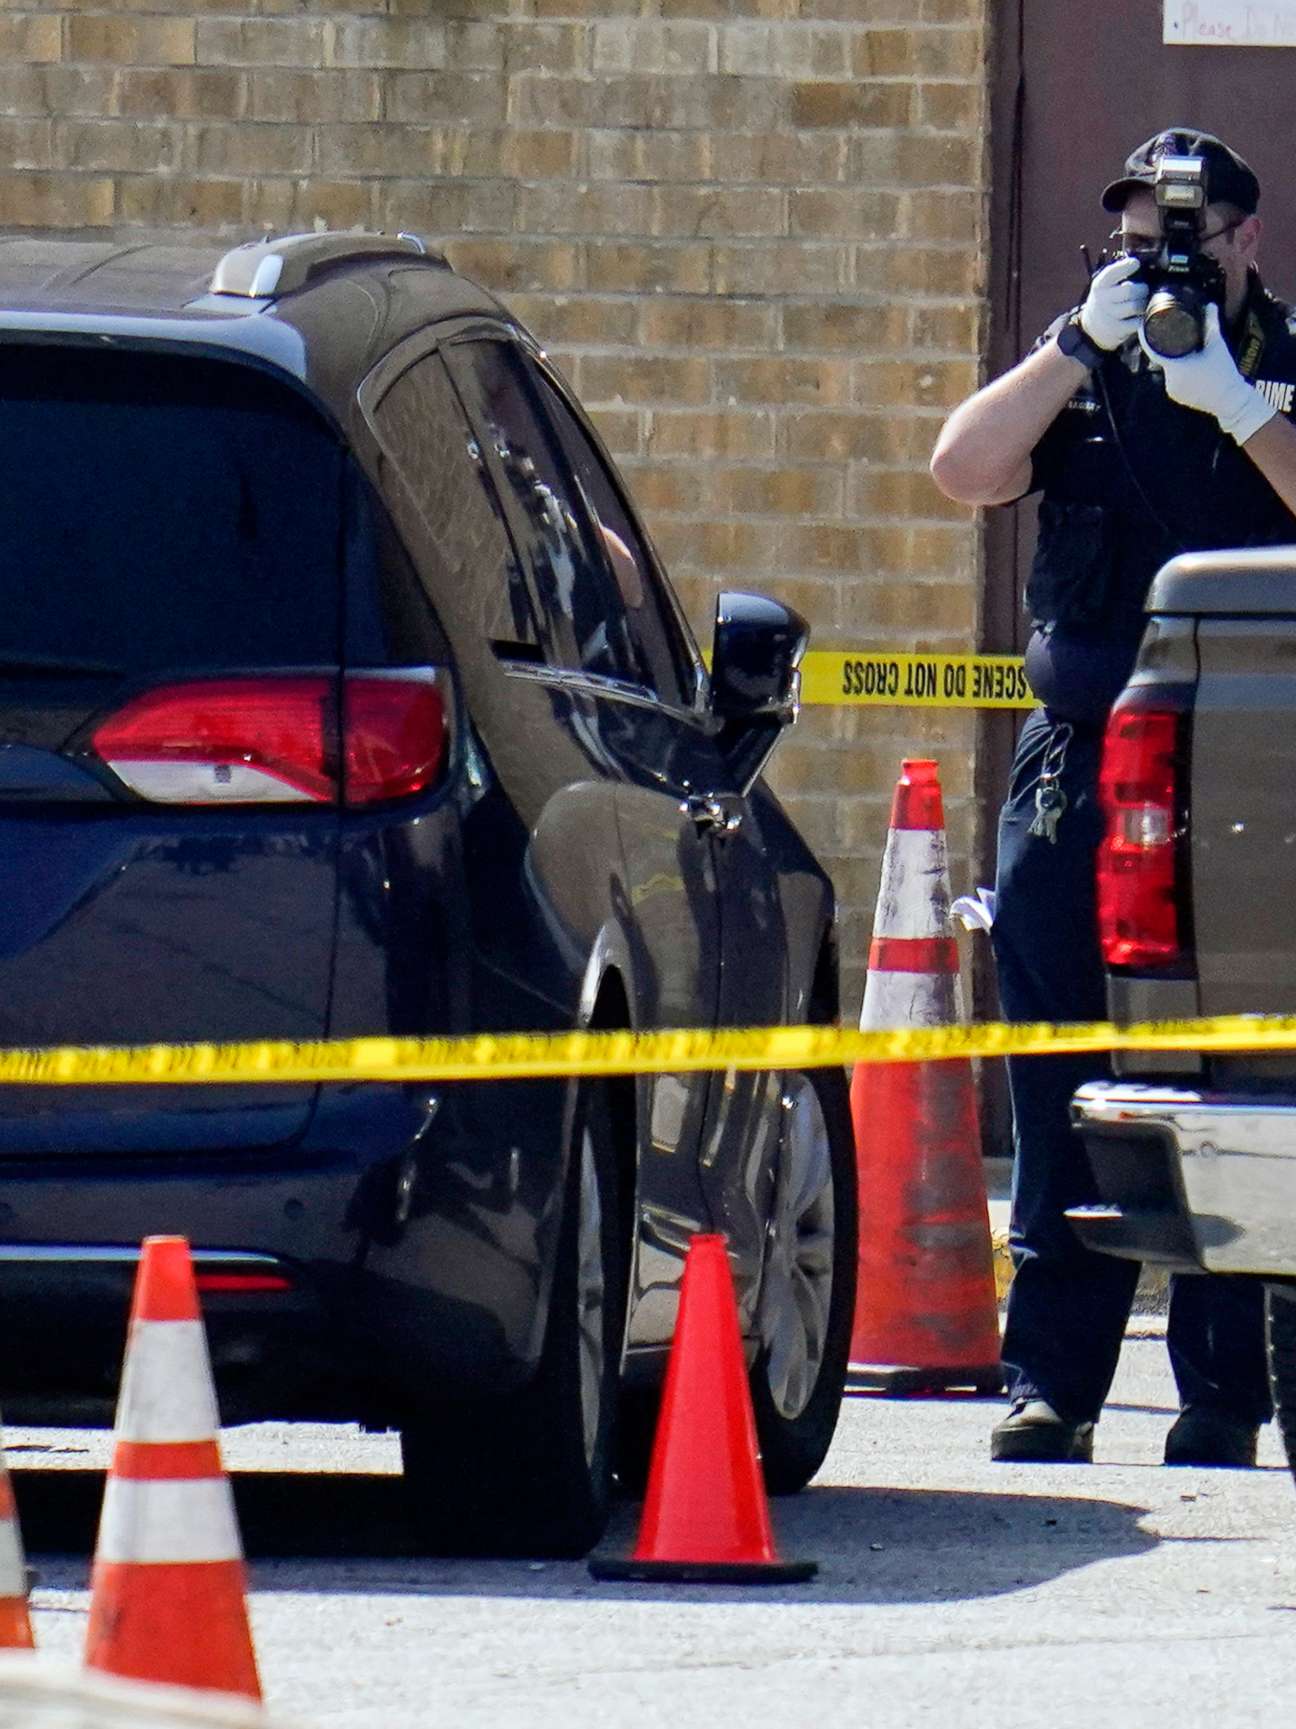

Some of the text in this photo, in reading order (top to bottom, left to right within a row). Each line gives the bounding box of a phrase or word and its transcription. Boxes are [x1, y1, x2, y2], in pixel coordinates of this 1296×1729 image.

[1255, 380, 1296, 412] RIME
[842, 659, 1028, 700] SCENE DO NOT CROSS
